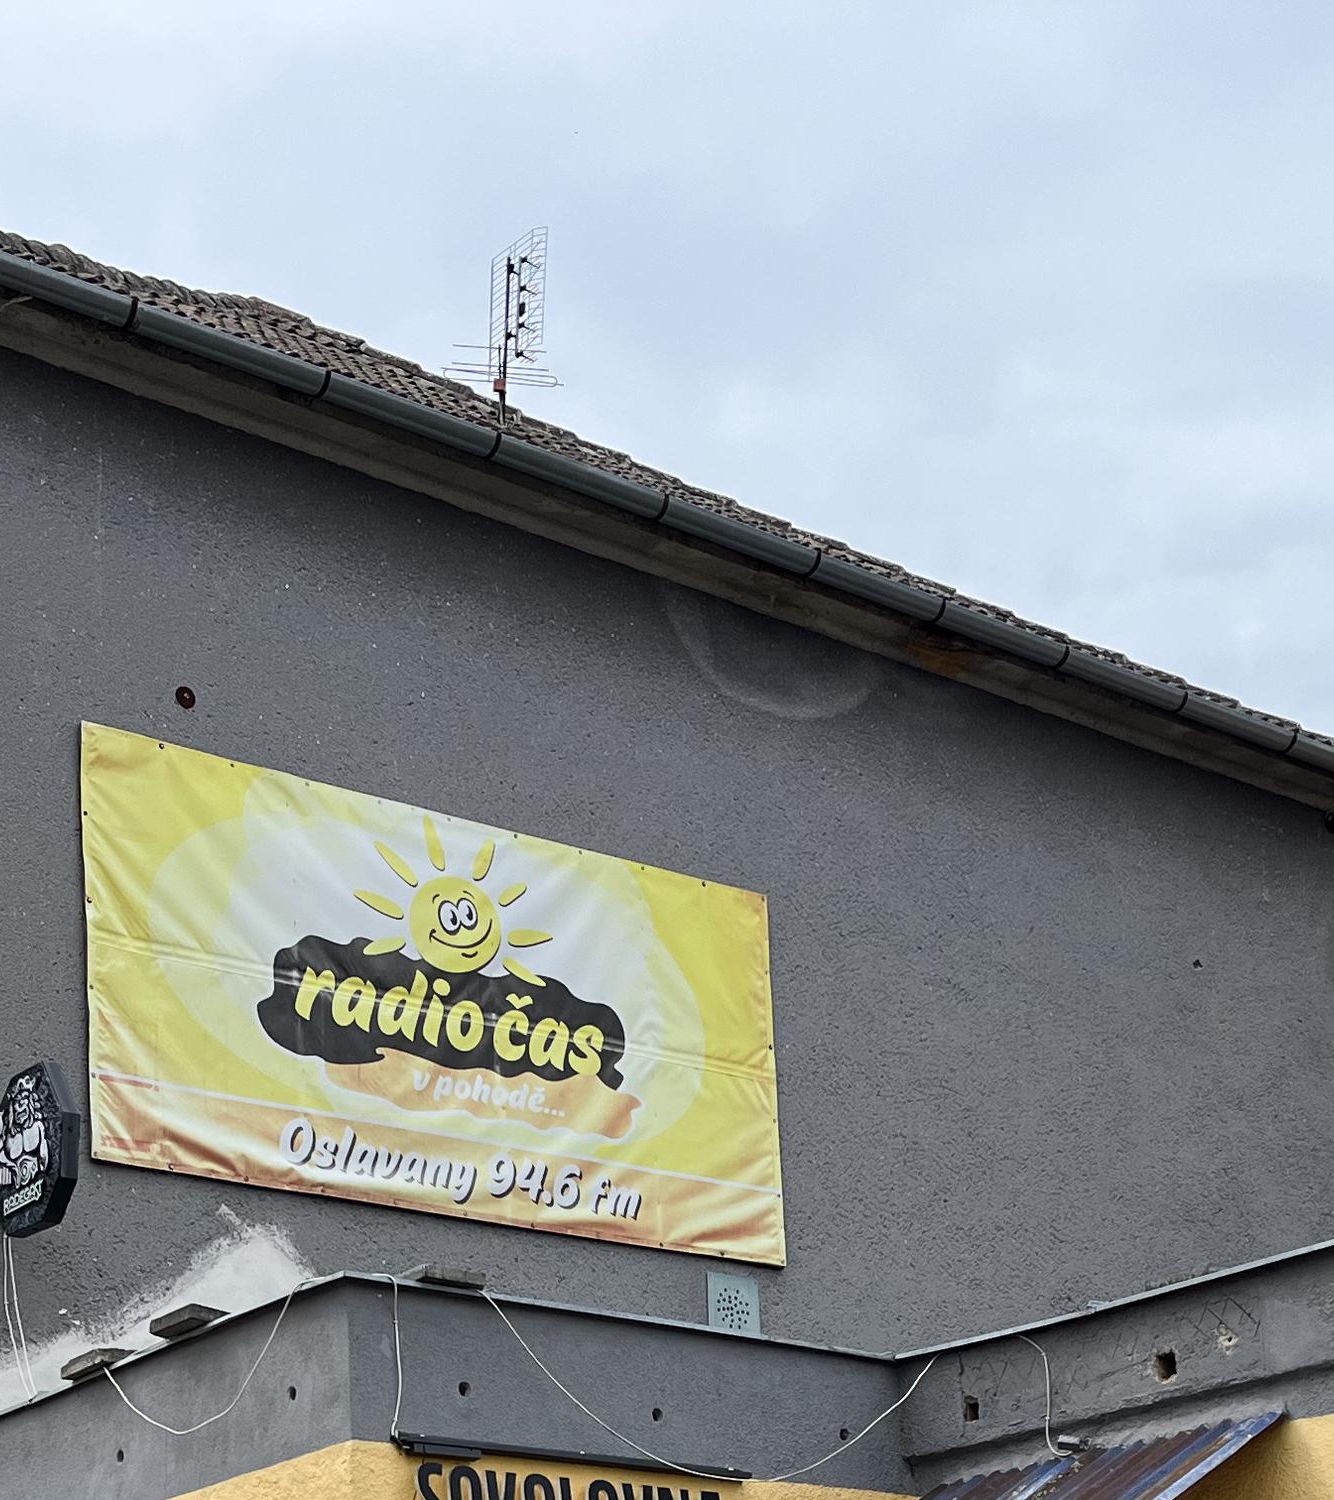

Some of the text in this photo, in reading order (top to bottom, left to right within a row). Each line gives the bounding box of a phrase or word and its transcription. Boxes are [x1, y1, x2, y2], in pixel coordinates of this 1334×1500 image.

[294, 966, 604, 1076] radio čas
[414, 1070, 429, 1091] v
[279, 1119, 642, 1220] Oslavany 94.6 fm
